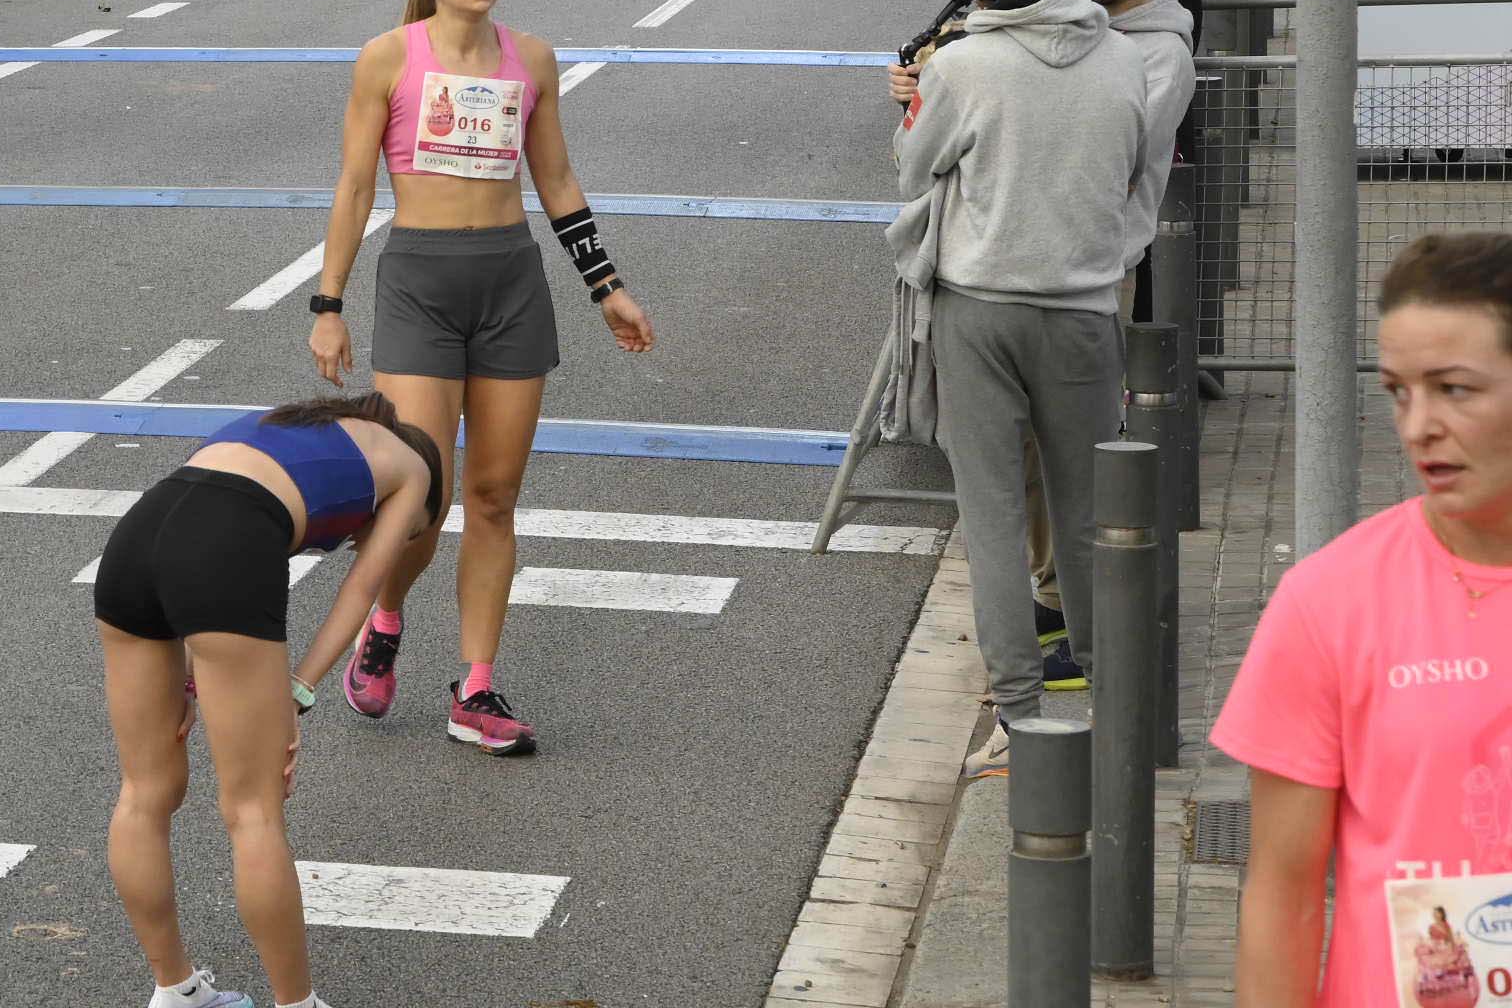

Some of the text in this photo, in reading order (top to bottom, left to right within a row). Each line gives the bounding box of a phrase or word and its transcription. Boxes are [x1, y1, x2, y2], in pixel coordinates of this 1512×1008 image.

[458, 116, 492, 132] 016
[468, 135, 477, 144] 23
[1388, 656, 1488, 689] OYSHO
